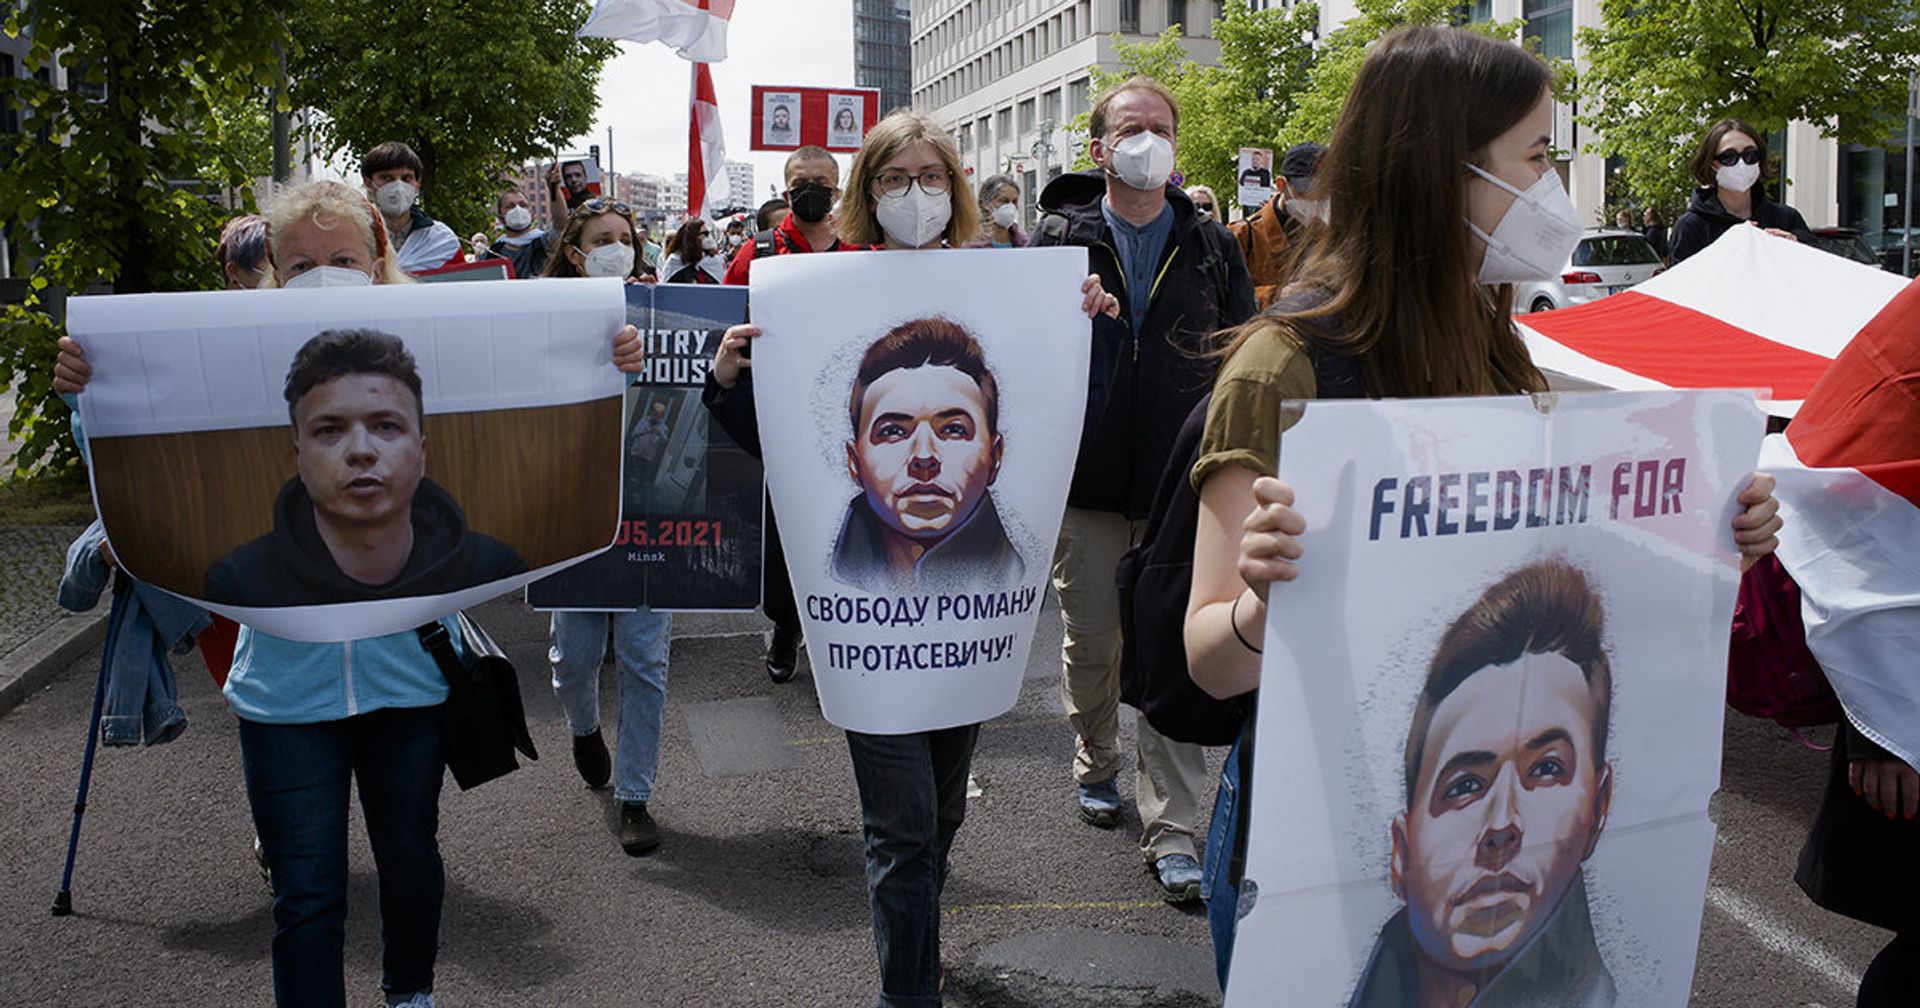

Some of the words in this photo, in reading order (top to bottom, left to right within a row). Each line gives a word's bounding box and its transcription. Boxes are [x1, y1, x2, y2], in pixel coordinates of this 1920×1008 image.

[1369, 465, 1592, 541] FREEDOM
[1610, 458, 1687, 520] FOR
[627, 551, 666, 561] Minsk
[806, 594, 930, 628] СВОБОДУ
[936, 586, 1036, 621] РОМАНУ
[828, 633, 1014, 671] ПРОТАСЕВИЧУ!
